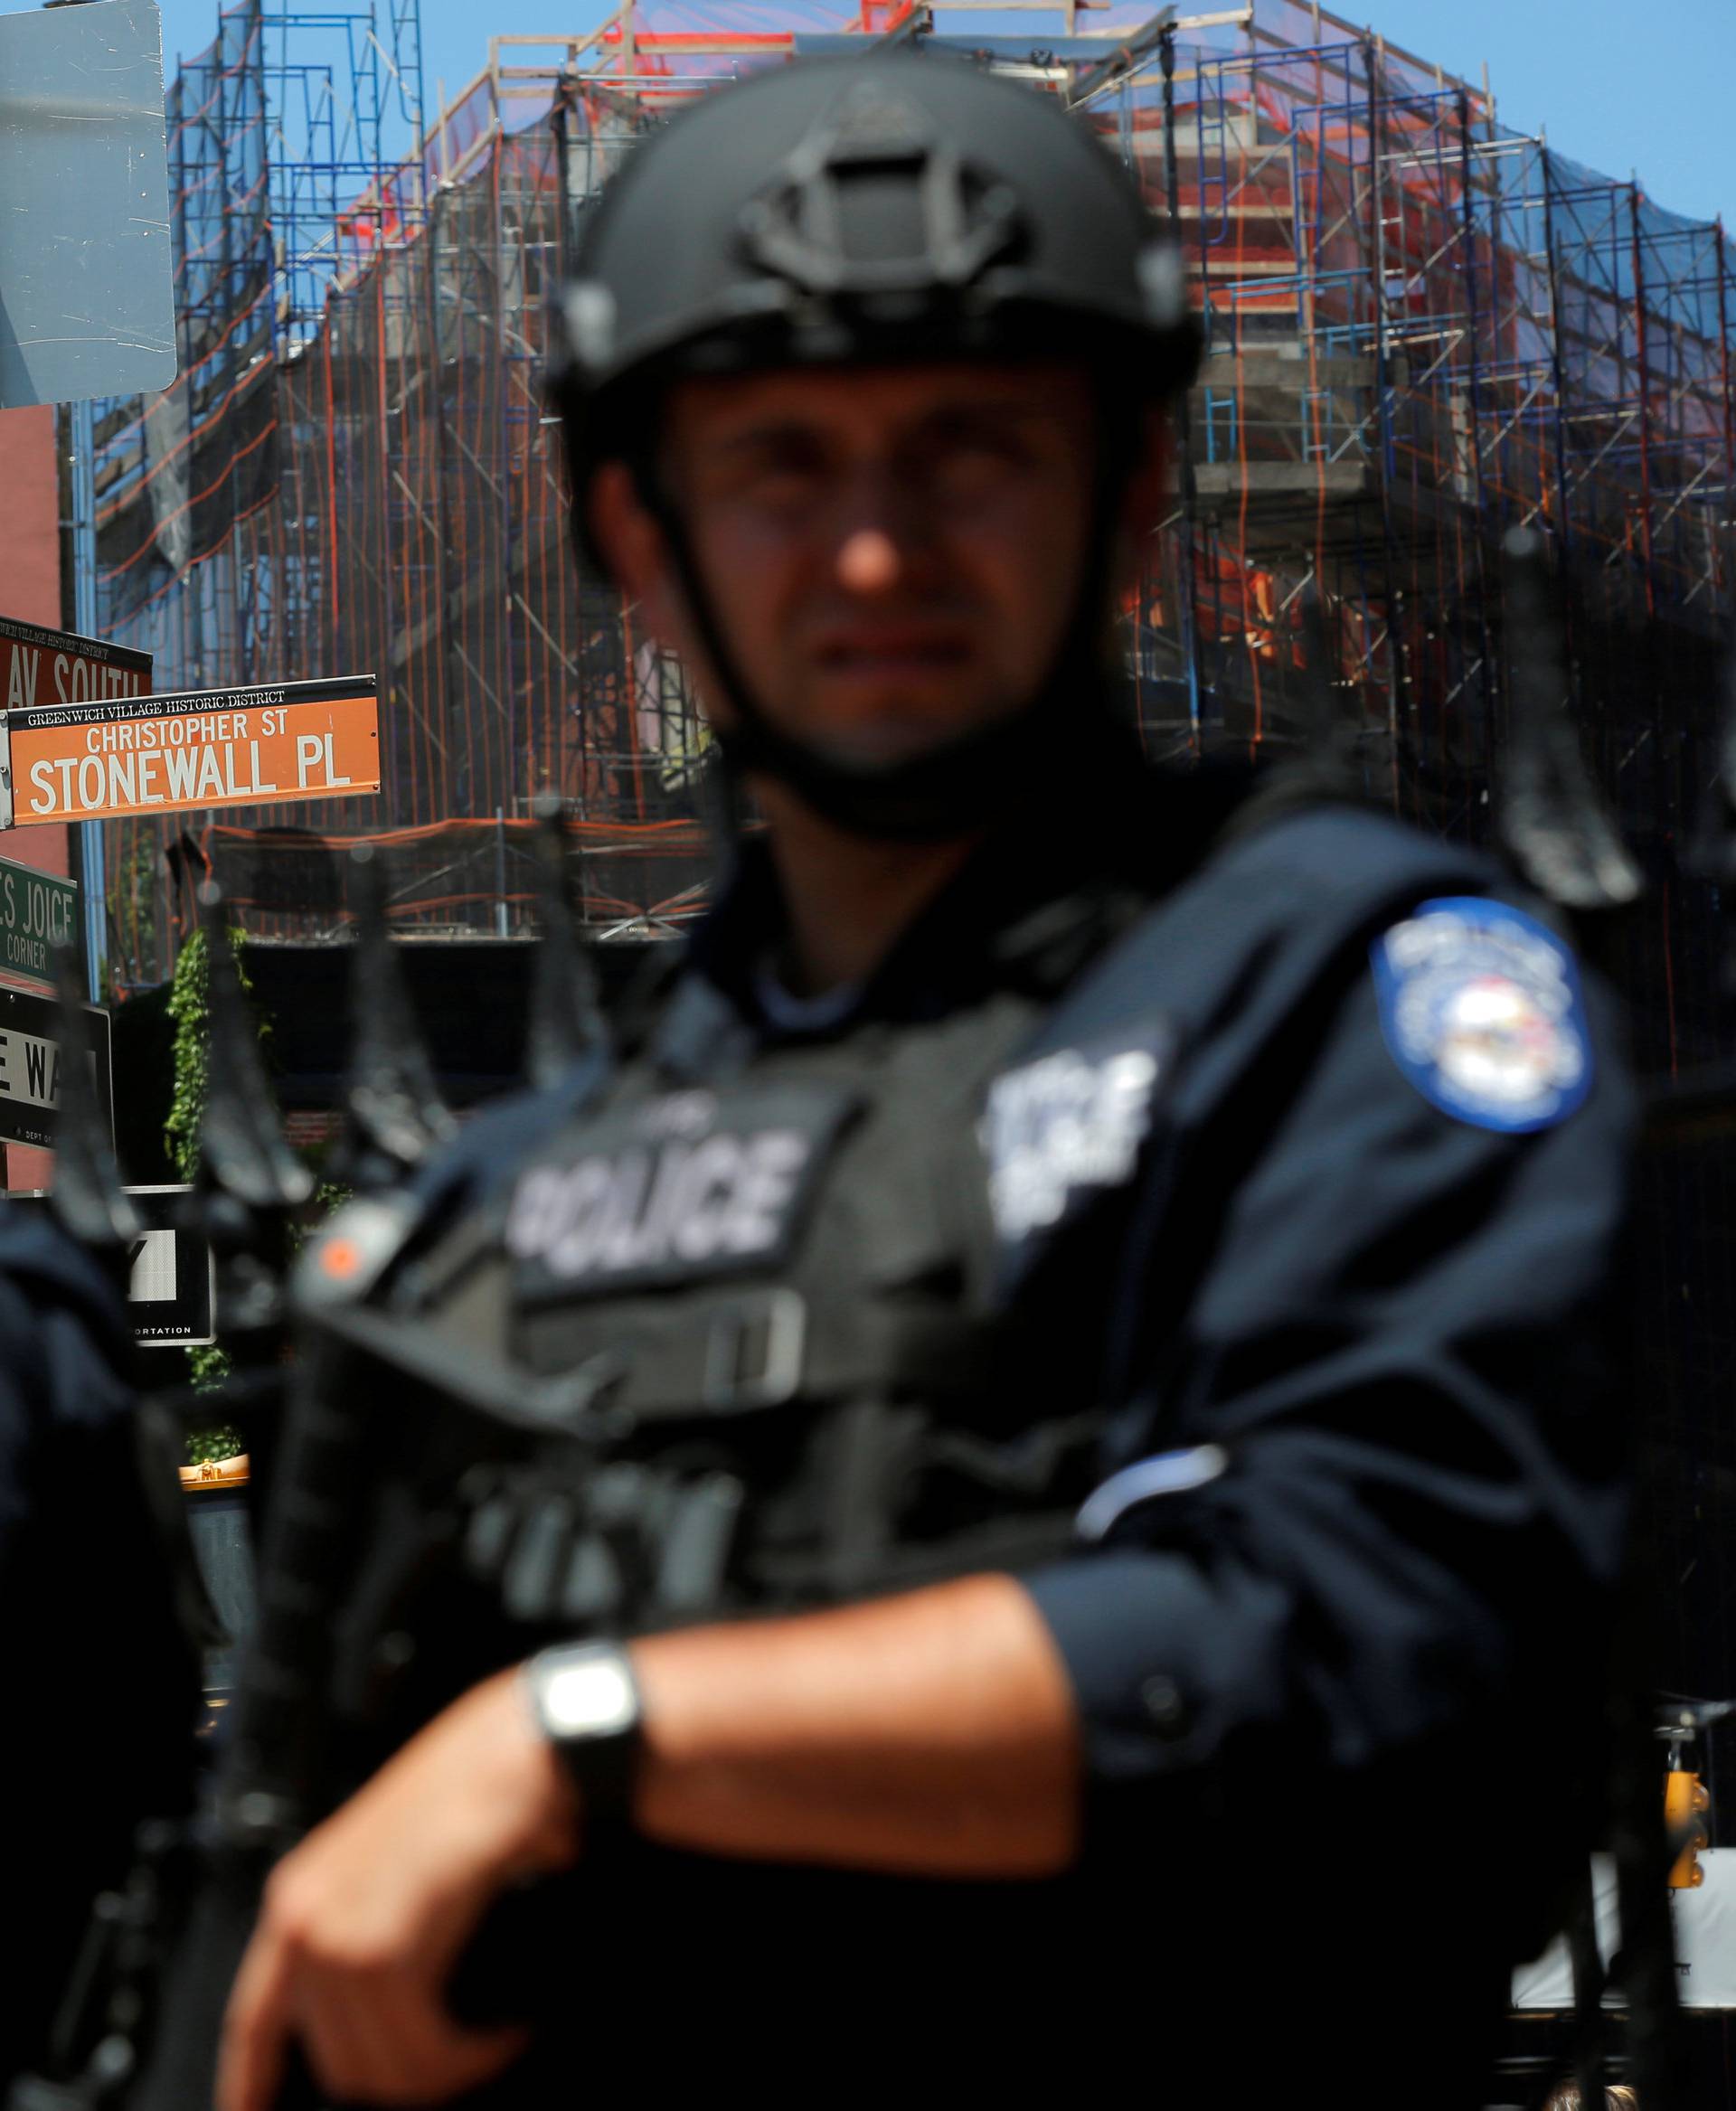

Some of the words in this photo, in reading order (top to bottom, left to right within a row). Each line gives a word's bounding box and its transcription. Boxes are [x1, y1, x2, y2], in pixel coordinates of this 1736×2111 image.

[18, 627, 46, 645] VILLAGE
[48, 635, 79, 652] HISTORIC
[80, 642, 108, 660] DISTRICT
[7, 643, 39, 710] AV
[28, 708, 105, 727] GREENWICH
[109, 702, 163, 720] VILLAGE
[166, 695, 225, 713] HISTORIC
[228, 690, 286, 708] DISTRICT
[86, 712, 248, 754] CHRISTOPHER
[261, 708, 289, 737] ST
[30, 740, 277, 815] STONEWALL
[297, 732, 352, 790] PL
[0, 871, 15, 928] S
[7, 932, 47, 971] CORNER
[25, 1130, 42, 1141] DEPT
[506, 1130, 808, 1276] POLICE
[134, 1326, 191, 1335] ORTATION
